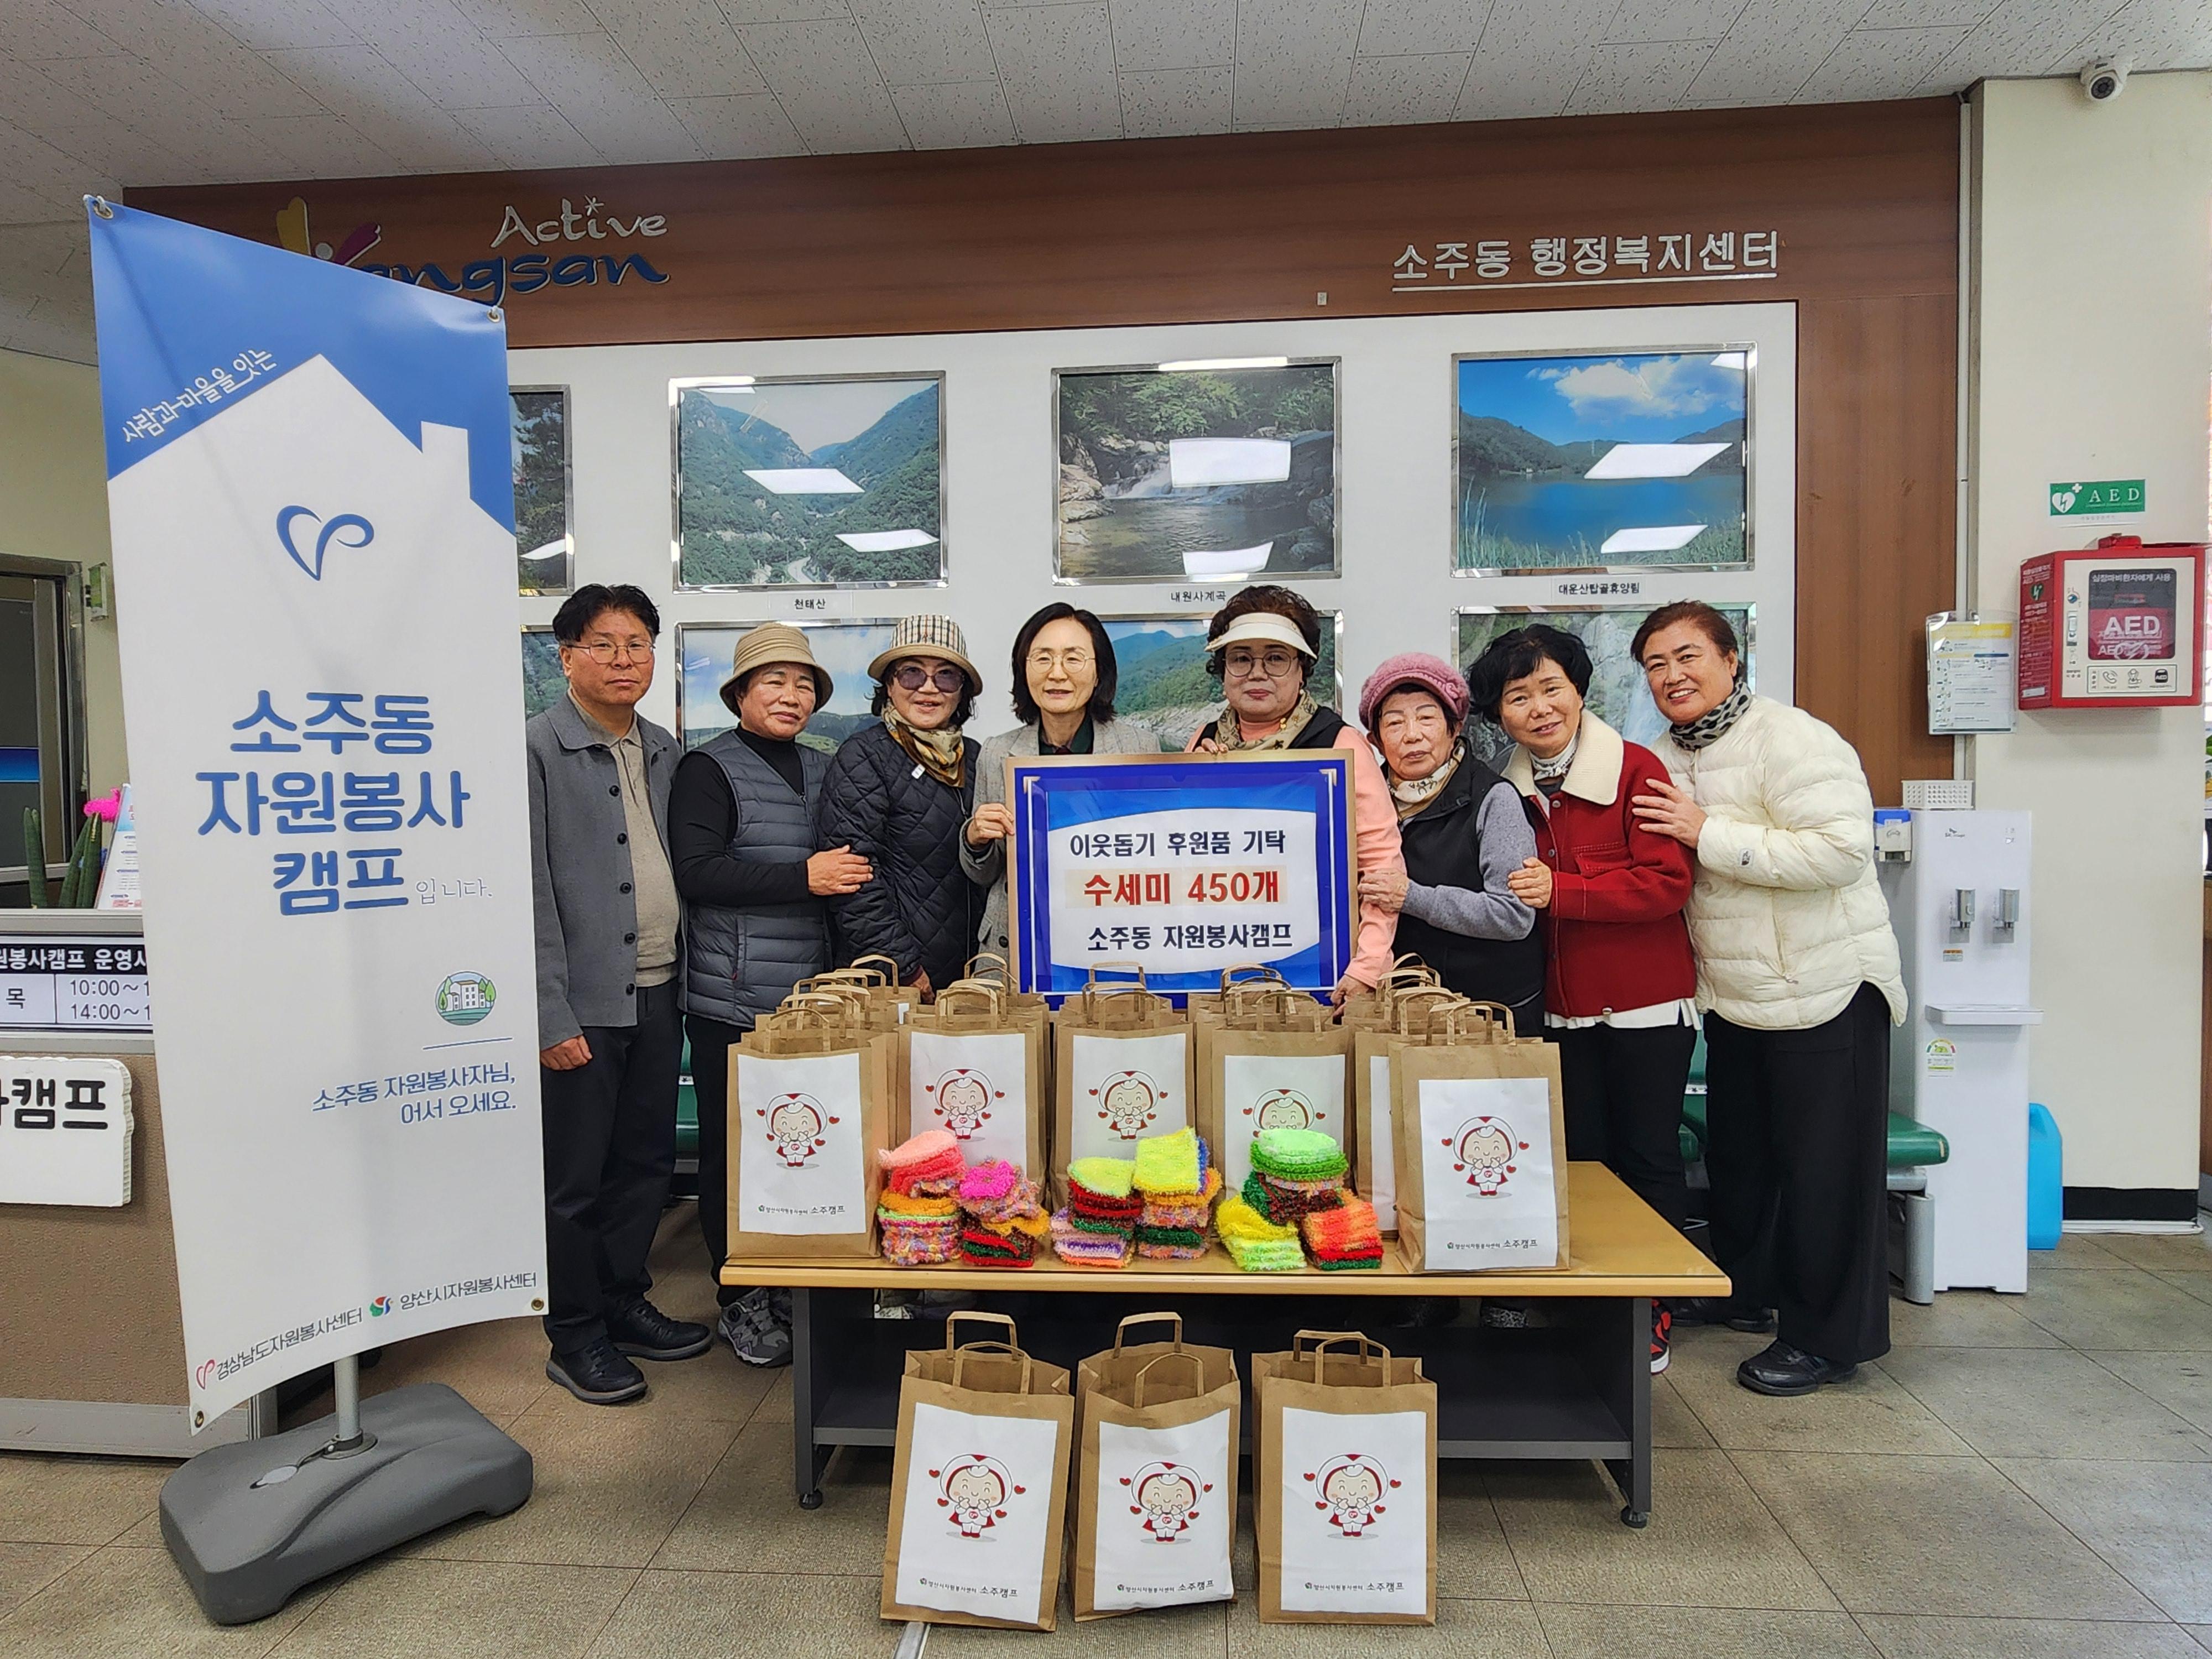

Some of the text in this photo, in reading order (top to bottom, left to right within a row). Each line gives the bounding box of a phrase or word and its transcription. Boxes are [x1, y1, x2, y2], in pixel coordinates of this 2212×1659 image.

[491, 195, 667, 248] Active
[1393, 231, 1778, 280] 소주동 행정복지센터
[2089, 488, 2140, 503] AED
[1171, 591, 1226, 602] 내원사계곡
[1558, 582, 1640, 595] 대운산탑골휴양림
[794, 598, 826, 609] 천태산
[2104, 615, 2161, 635] AED
[230, 690, 434, 755] 소주동
[196, 771, 470, 836] 자원봉사
[1070, 830, 1286, 858] 이웃돕기 후원품 기탁
[273, 848, 493, 916] 캠프 입니다.
[1084, 870, 1279, 906] 수세미 450개
[1087, 923, 1293, 951] 소주동 자원봉사캠프
[6, 988, 26, 1009] 목
[312, 1062, 515, 1112] 소주동 자원봉사자님,
[0, 1078, 108, 1130] 캠프
[401, 1090, 517, 1124] 어서 오세요.
[810, 1206, 846, 1215] 소주캠프
[1503, 1239, 1538, 1249] 소주캠프
[216, 1272, 536, 1380] 경상남도자원봉사센터 양산시자원봉사센터
[979, 1585, 1018, 1598] 소주캠프
[1178, 1579, 1214, 1591] 소주캠프
[1366, 1582, 1405, 1592] 소주캠프
